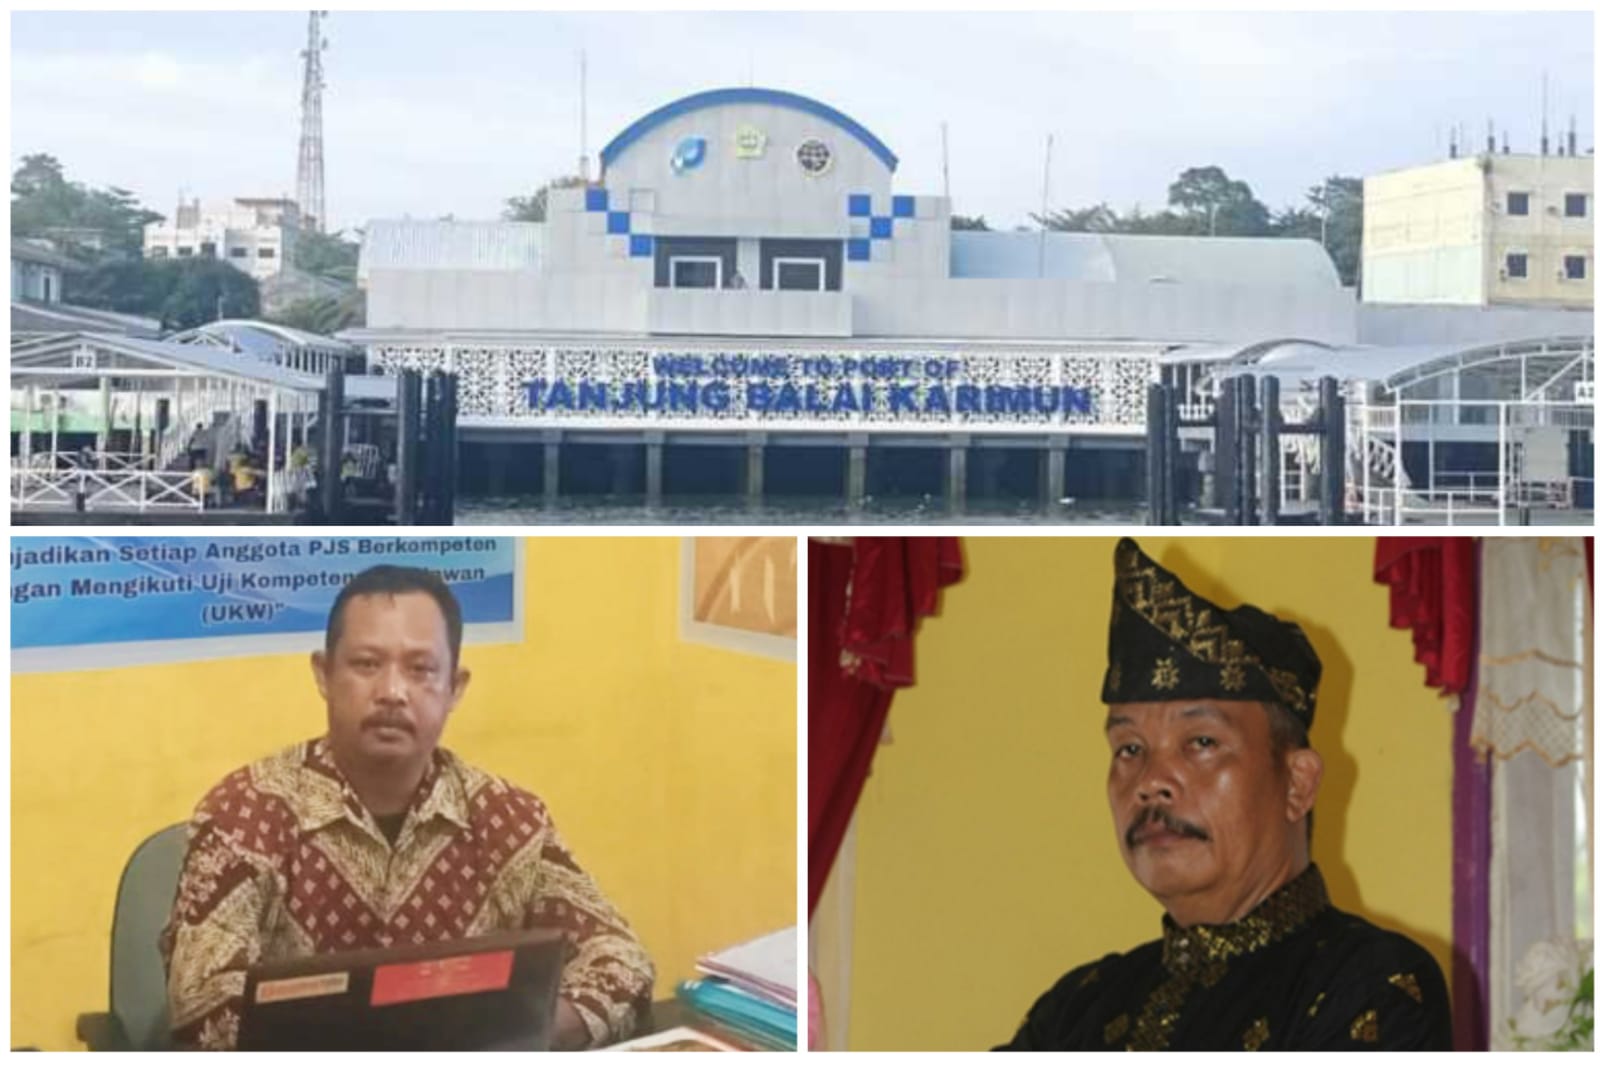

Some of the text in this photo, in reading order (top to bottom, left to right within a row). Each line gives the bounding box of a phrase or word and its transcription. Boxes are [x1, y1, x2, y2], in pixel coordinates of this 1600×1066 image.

[652, 355, 961, 377] WELCOME TO PORT OF
[521, 378, 1094, 414] TANJUNG BALAI KARIMUN
[119, 543, 197, 564] Setiap
[205, 541, 301, 563] Anggota
[309, 538, 350, 556] PJS
[358, 536, 497, 555] Berkompeten
[10, 581, 62, 604] gan
[71, 574, 193, 599] Mengikuti
[202, 572, 233, 594] Uji
[241, 570, 353, 591] Kompeten
